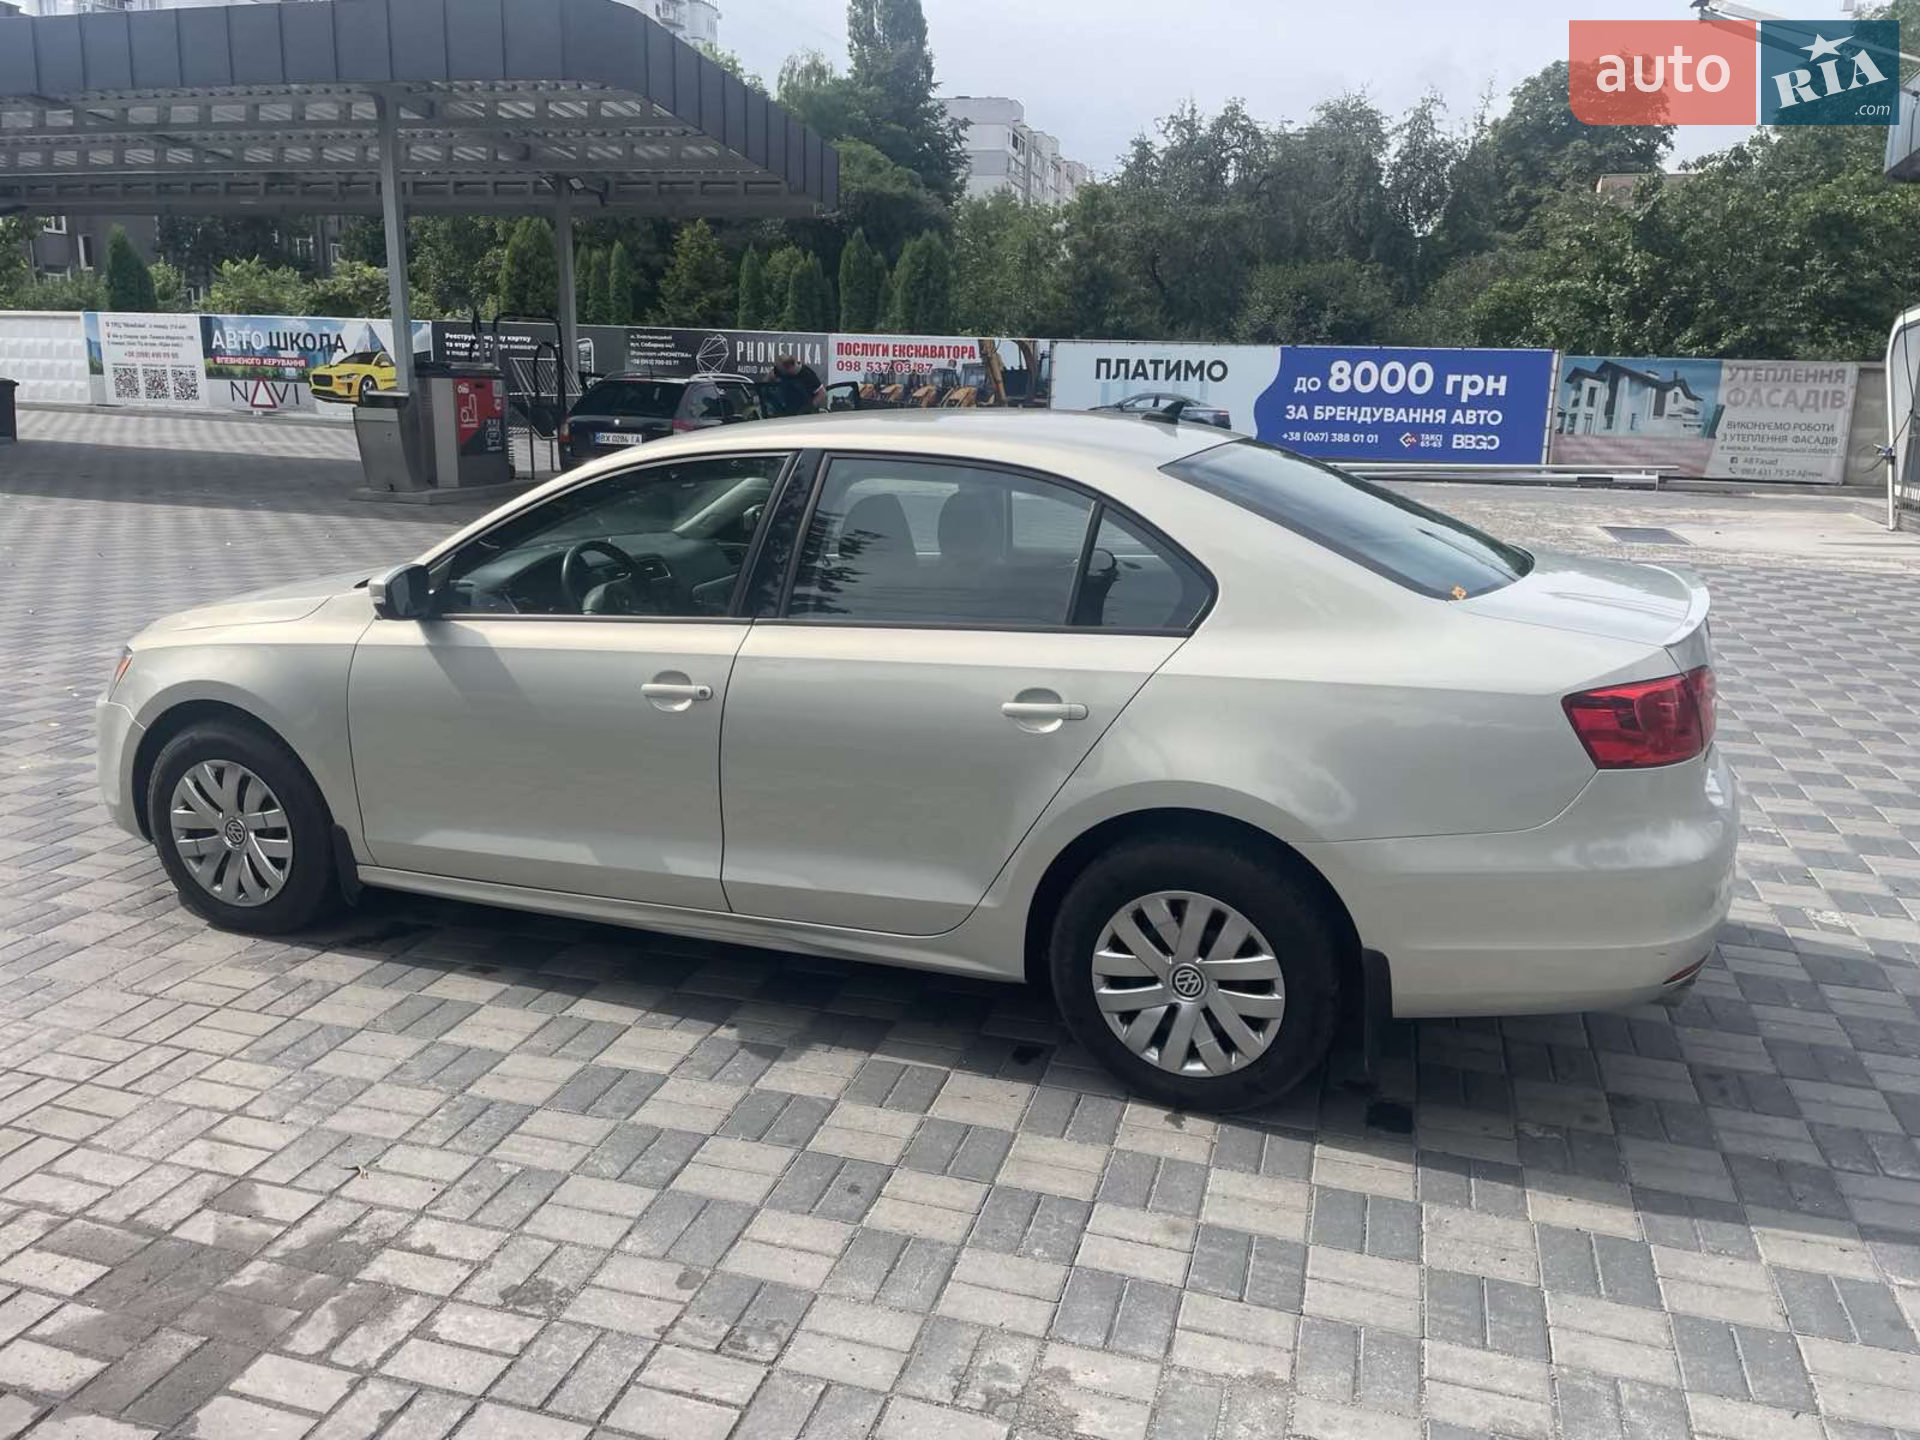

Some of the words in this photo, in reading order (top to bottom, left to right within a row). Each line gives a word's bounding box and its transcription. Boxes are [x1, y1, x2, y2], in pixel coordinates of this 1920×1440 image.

[211, 329, 265, 350] АВТО
[268, 331, 348, 353] ШКОЛА
[737, 341, 821, 365] PHONETIKA
[836, 342, 889, 357] ПОСЛУГИ
[892, 344, 976, 359] ЕКСКАВАТОРА
[216, 357, 261, 366] ВПЕВНЕНОГО
[263, 358, 306, 368] КЕРУВАННЯ
[836, 360, 861, 372] 098
[866, 361, 890, 373] 537
[895, 362, 912, 374] 03
[916, 363, 933, 374] 87
[1095, 358, 1229, 383] ПЛАТИМО
[1328, 360, 1434, 395] 8000
[1445, 374, 1508, 403] грн
[1727, 366, 1846, 384] УТЕПЛЕННЯ
[1726, 387, 1846, 413] ФАСАДІВ
[1285, 405, 1308, 420] ЗА
[1313, 405, 1446, 424] БРЕНДУВАННЯ
[1450, 409, 1503, 426] АВТО
[1726, 421, 1791, 431] ВИКОНУЄМО
[1793, 422, 1835, 432] РОБОТИ
[1282, 431, 1301, 442] +38
[1303, 432, 1329, 443] (067)
[1331, 433, 1351, 443] 388
[1353, 433, 1364, 443] 01
[1367, 434, 1379, 444] 01
[1729, 433, 1788, 443] УТЕПЛЕННЯ
[1791, 435, 1838, 446] ФАСАДІВ
